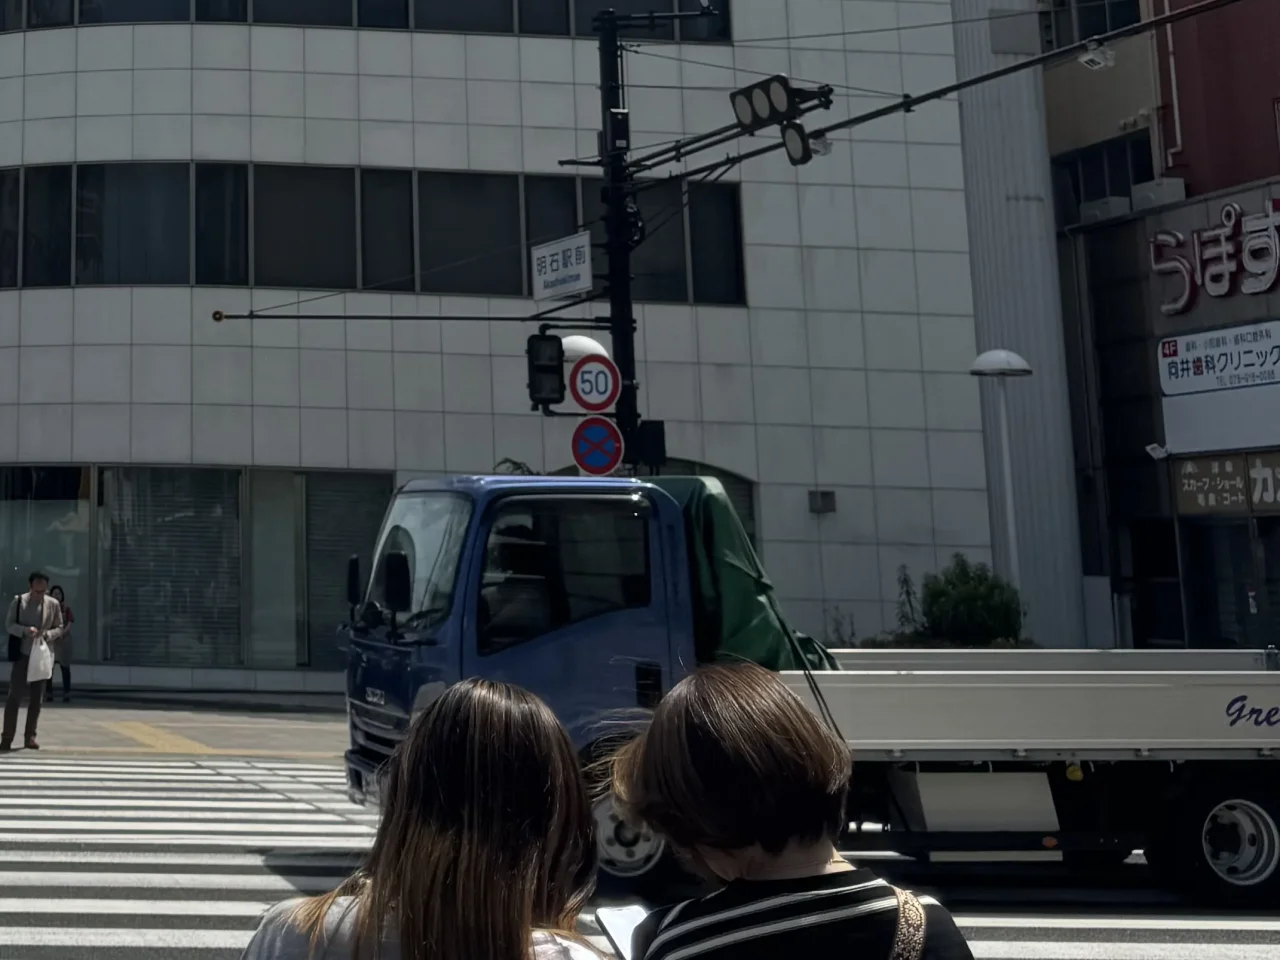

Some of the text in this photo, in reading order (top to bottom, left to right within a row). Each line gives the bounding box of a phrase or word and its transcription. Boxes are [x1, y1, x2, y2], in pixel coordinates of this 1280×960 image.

[536, 245, 586, 276] 明石駅前
[1163, 340, 1178, 356] 4F
[1168, 345, 1280, 381] 向井歯科クリニック
[581, 370, 609, 395] 50
